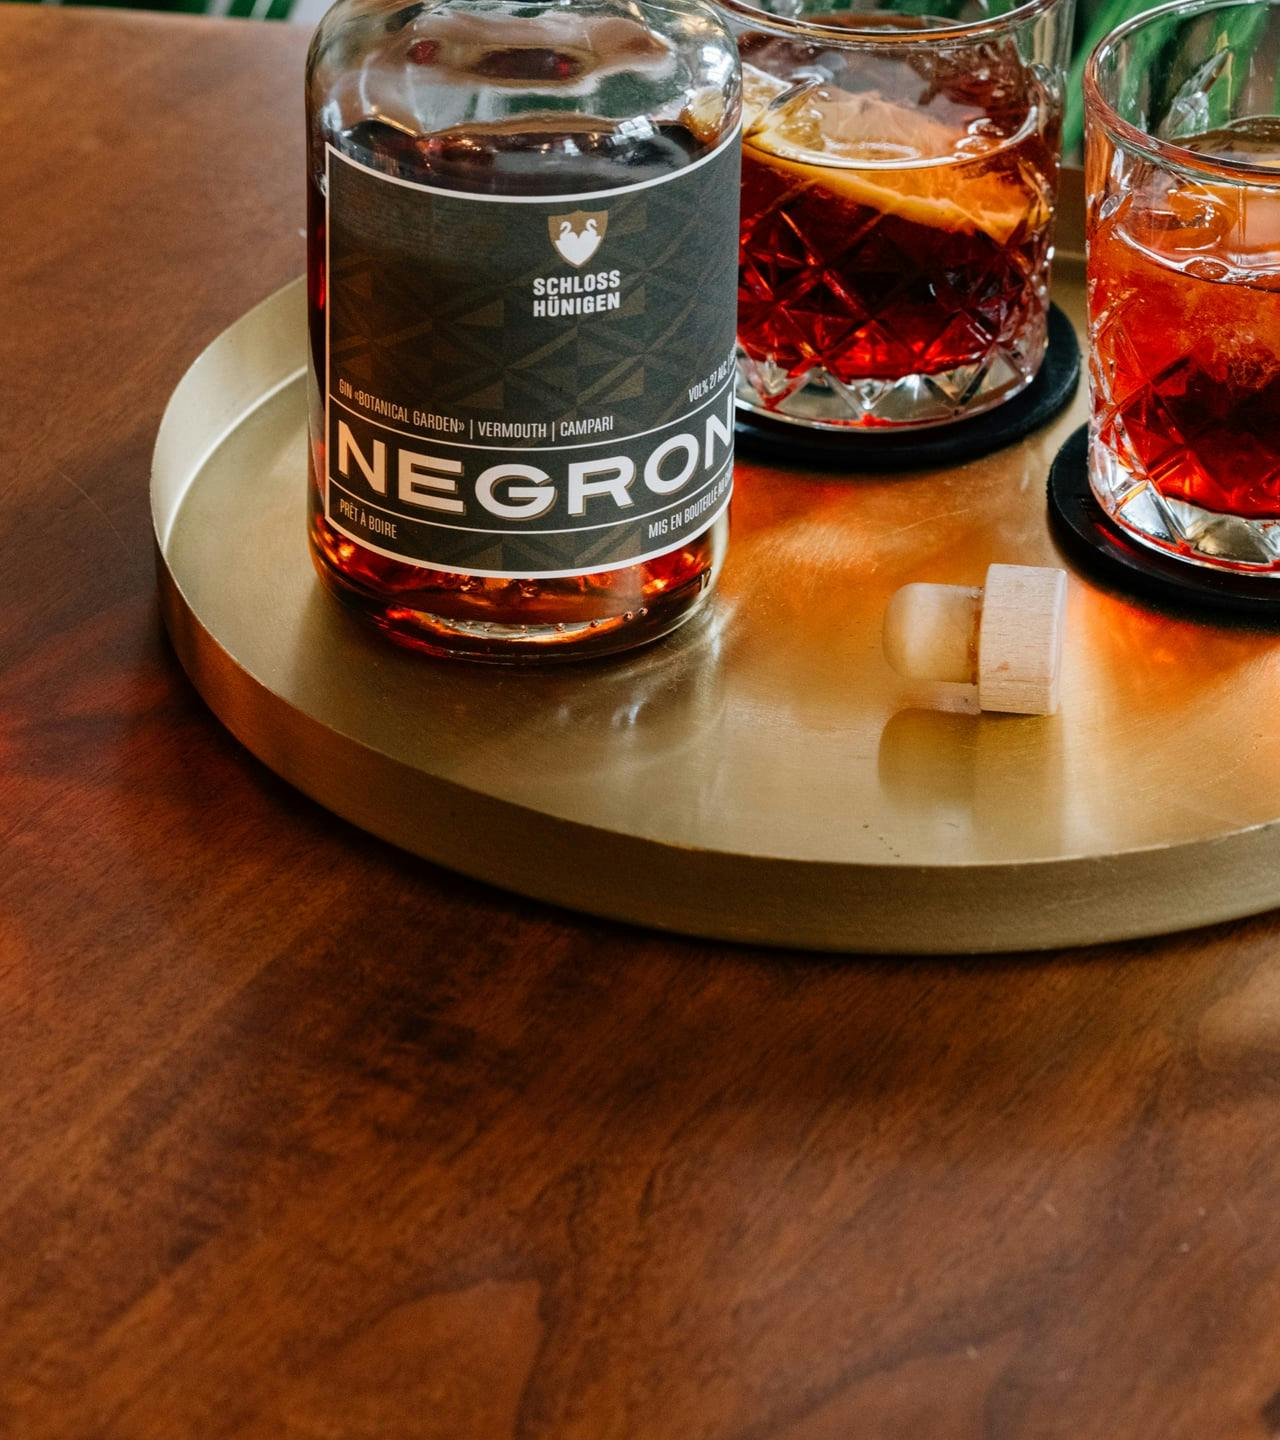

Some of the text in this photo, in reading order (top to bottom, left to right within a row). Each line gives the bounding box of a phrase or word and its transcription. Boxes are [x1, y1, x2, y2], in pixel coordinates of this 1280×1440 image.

[533, 269, 620, 296] SCHLOSS
[533, 291, 620, 317] HÜNIGEN
[339, 378, 353, 400] GIN
[477, 420, 547, 439] VERMOUTH
[559, 415, 614, 438] CAMPARI
[340, 497, 359, 522] PRÊT
[368, 515, 398, 540] BOIRE
[648, 518, 669, 539] MIS
[670, 511, 683, 531] EN
[684, 485, 718, 524] BOUTEILLE
